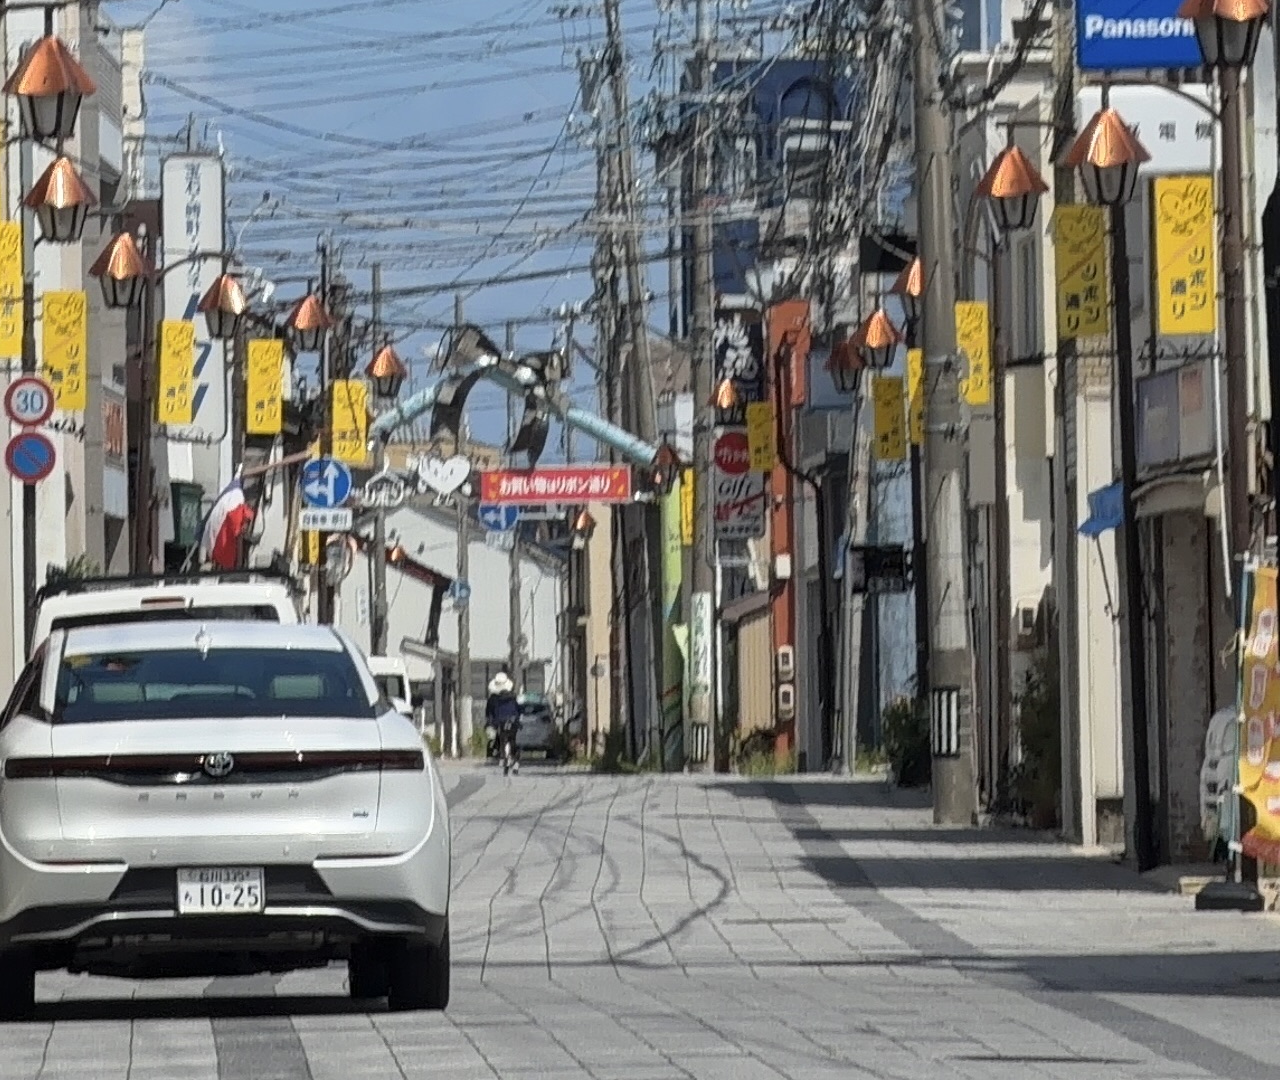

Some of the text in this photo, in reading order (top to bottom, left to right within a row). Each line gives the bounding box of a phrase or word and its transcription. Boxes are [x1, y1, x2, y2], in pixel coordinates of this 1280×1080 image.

[1081, 263, 1100, 324] リボン
[1189, 245, 1207, 311] リボン
[1065, 292, 1080, 331] 通り
[1171, 278, 1187, 320] 通り
[16, 389, 44, 414] 30
[500, 474, 611, 496] お買い物はリボン通り
[200, 883, 260, 908] 10-25
